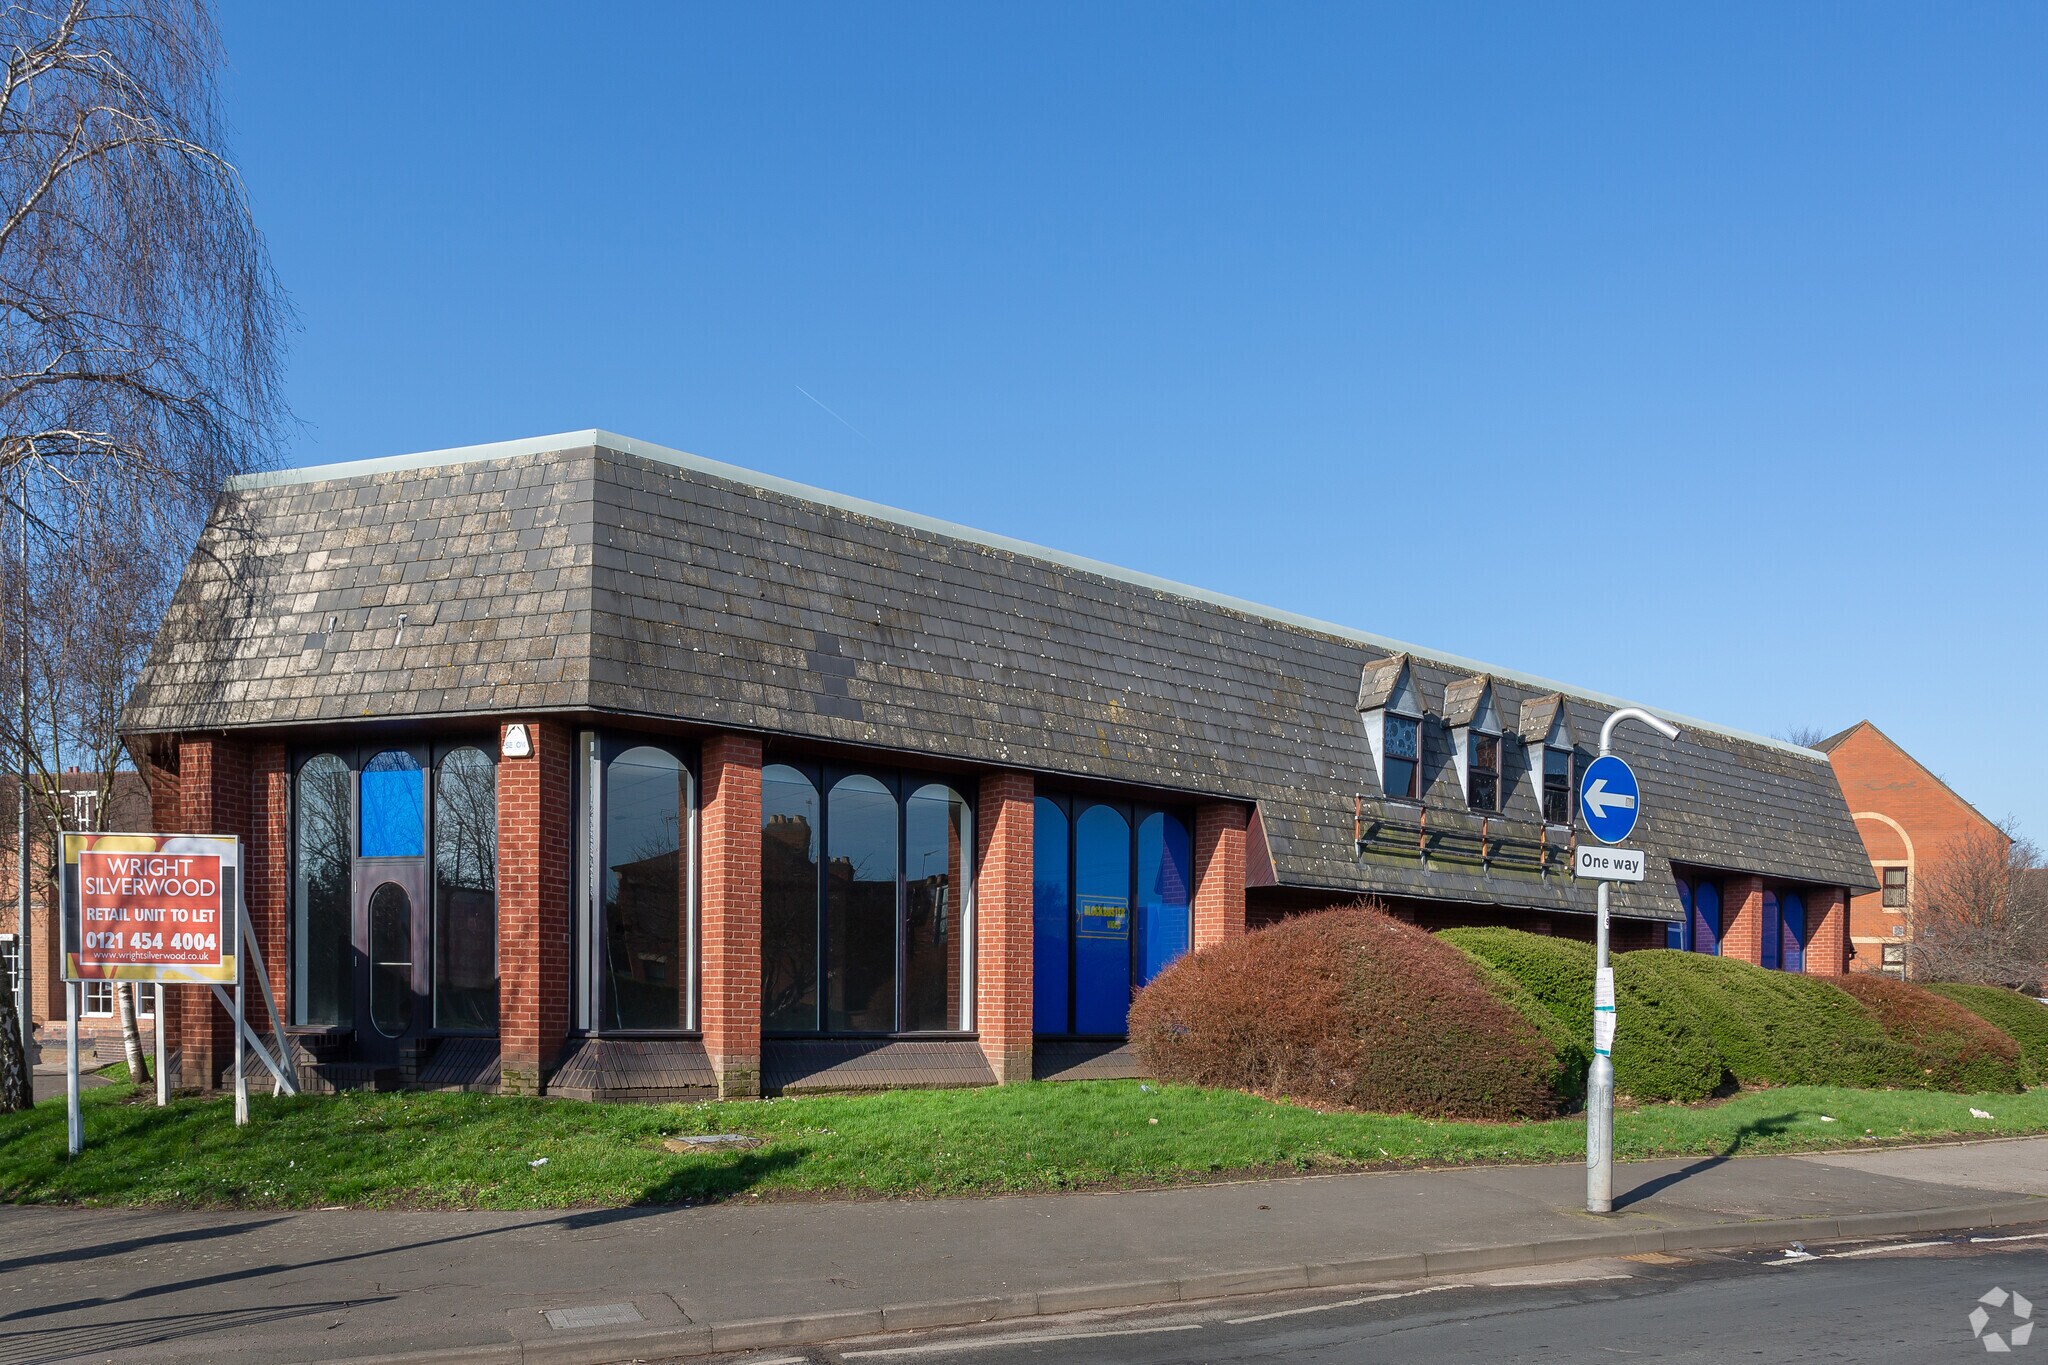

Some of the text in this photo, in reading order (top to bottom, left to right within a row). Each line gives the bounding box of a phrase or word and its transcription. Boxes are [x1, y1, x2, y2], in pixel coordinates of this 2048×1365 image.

[107, 858, 193, 876] WRIGHT
[1582, 853, 1639, 873] One way
[85, 877, 215, 896] SILVERWOOD
[87, 908, 215, 922] RETAIL UNIT TO LET
[86, 931, 216, 950] 0121 454 4004
[93, 951, 209, 961] www.wrightsilverwood.co.uk
